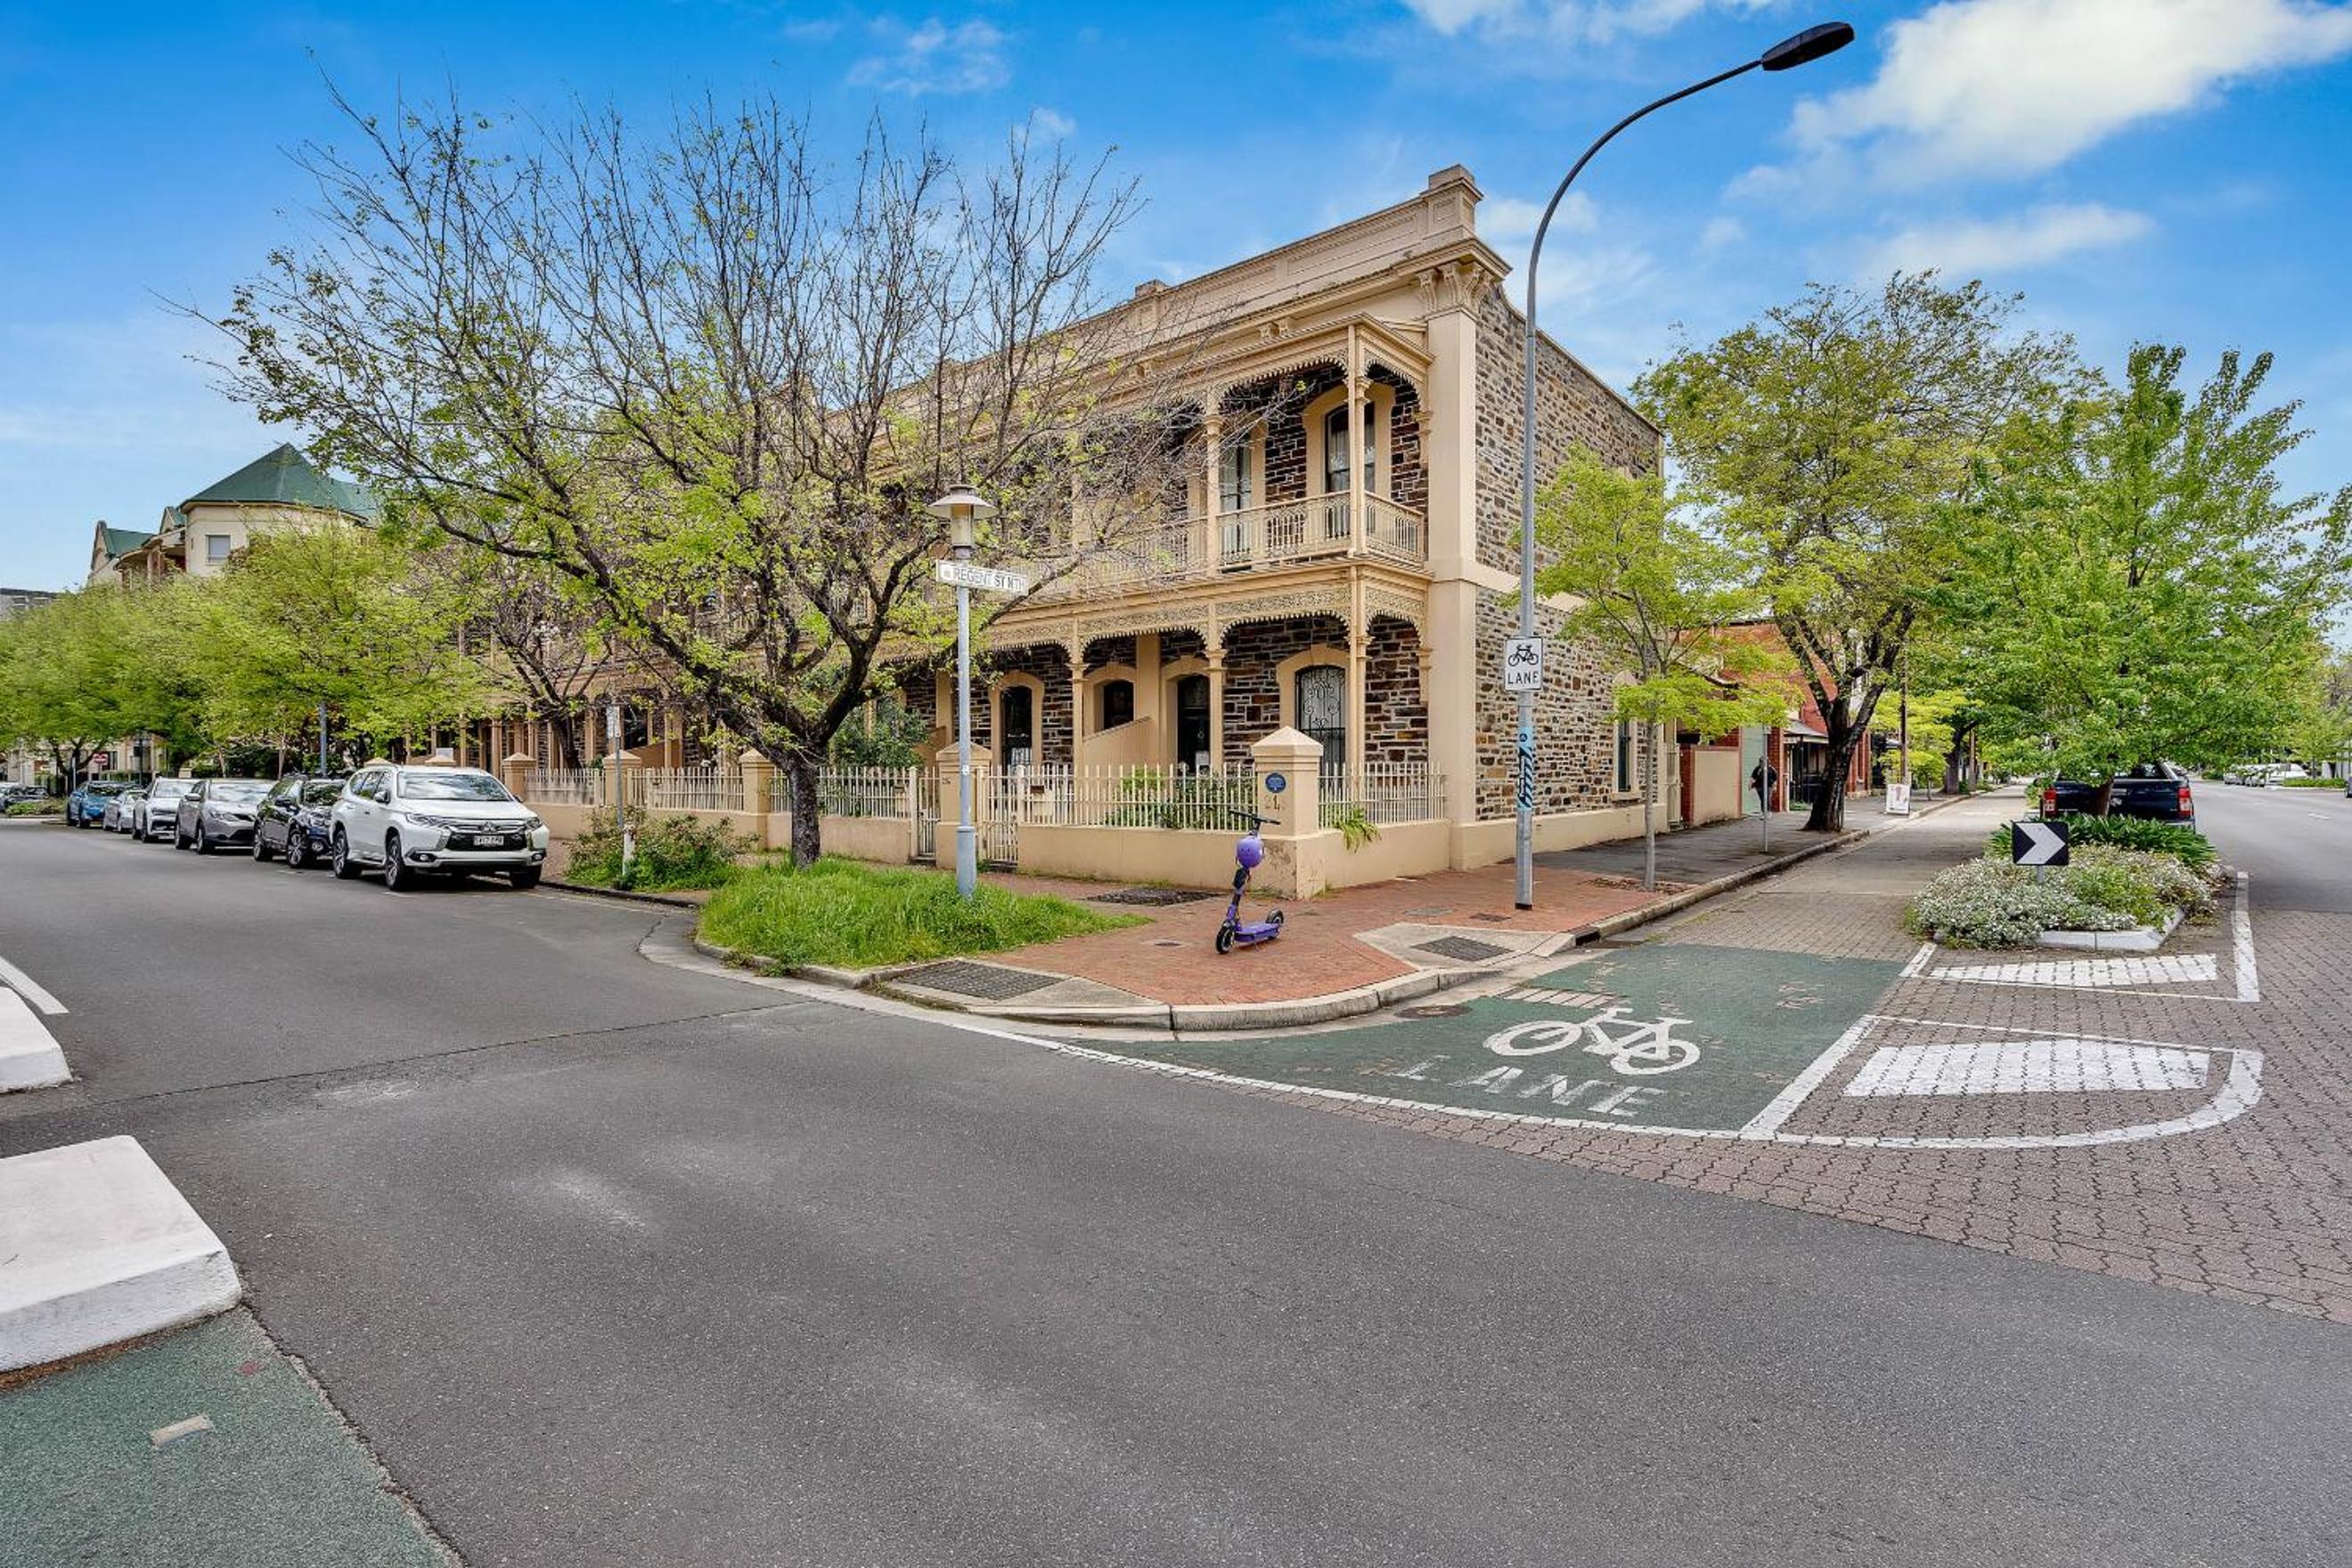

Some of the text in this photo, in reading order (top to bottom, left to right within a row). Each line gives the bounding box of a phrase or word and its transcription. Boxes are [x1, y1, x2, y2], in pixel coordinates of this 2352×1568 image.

[954, 568, 991, 584] REGENT
[993, 575, 1005, 587] ST
[1507, 671, 1539, 685] LANE
[1377, 1055, 1671, 1117] LANE
